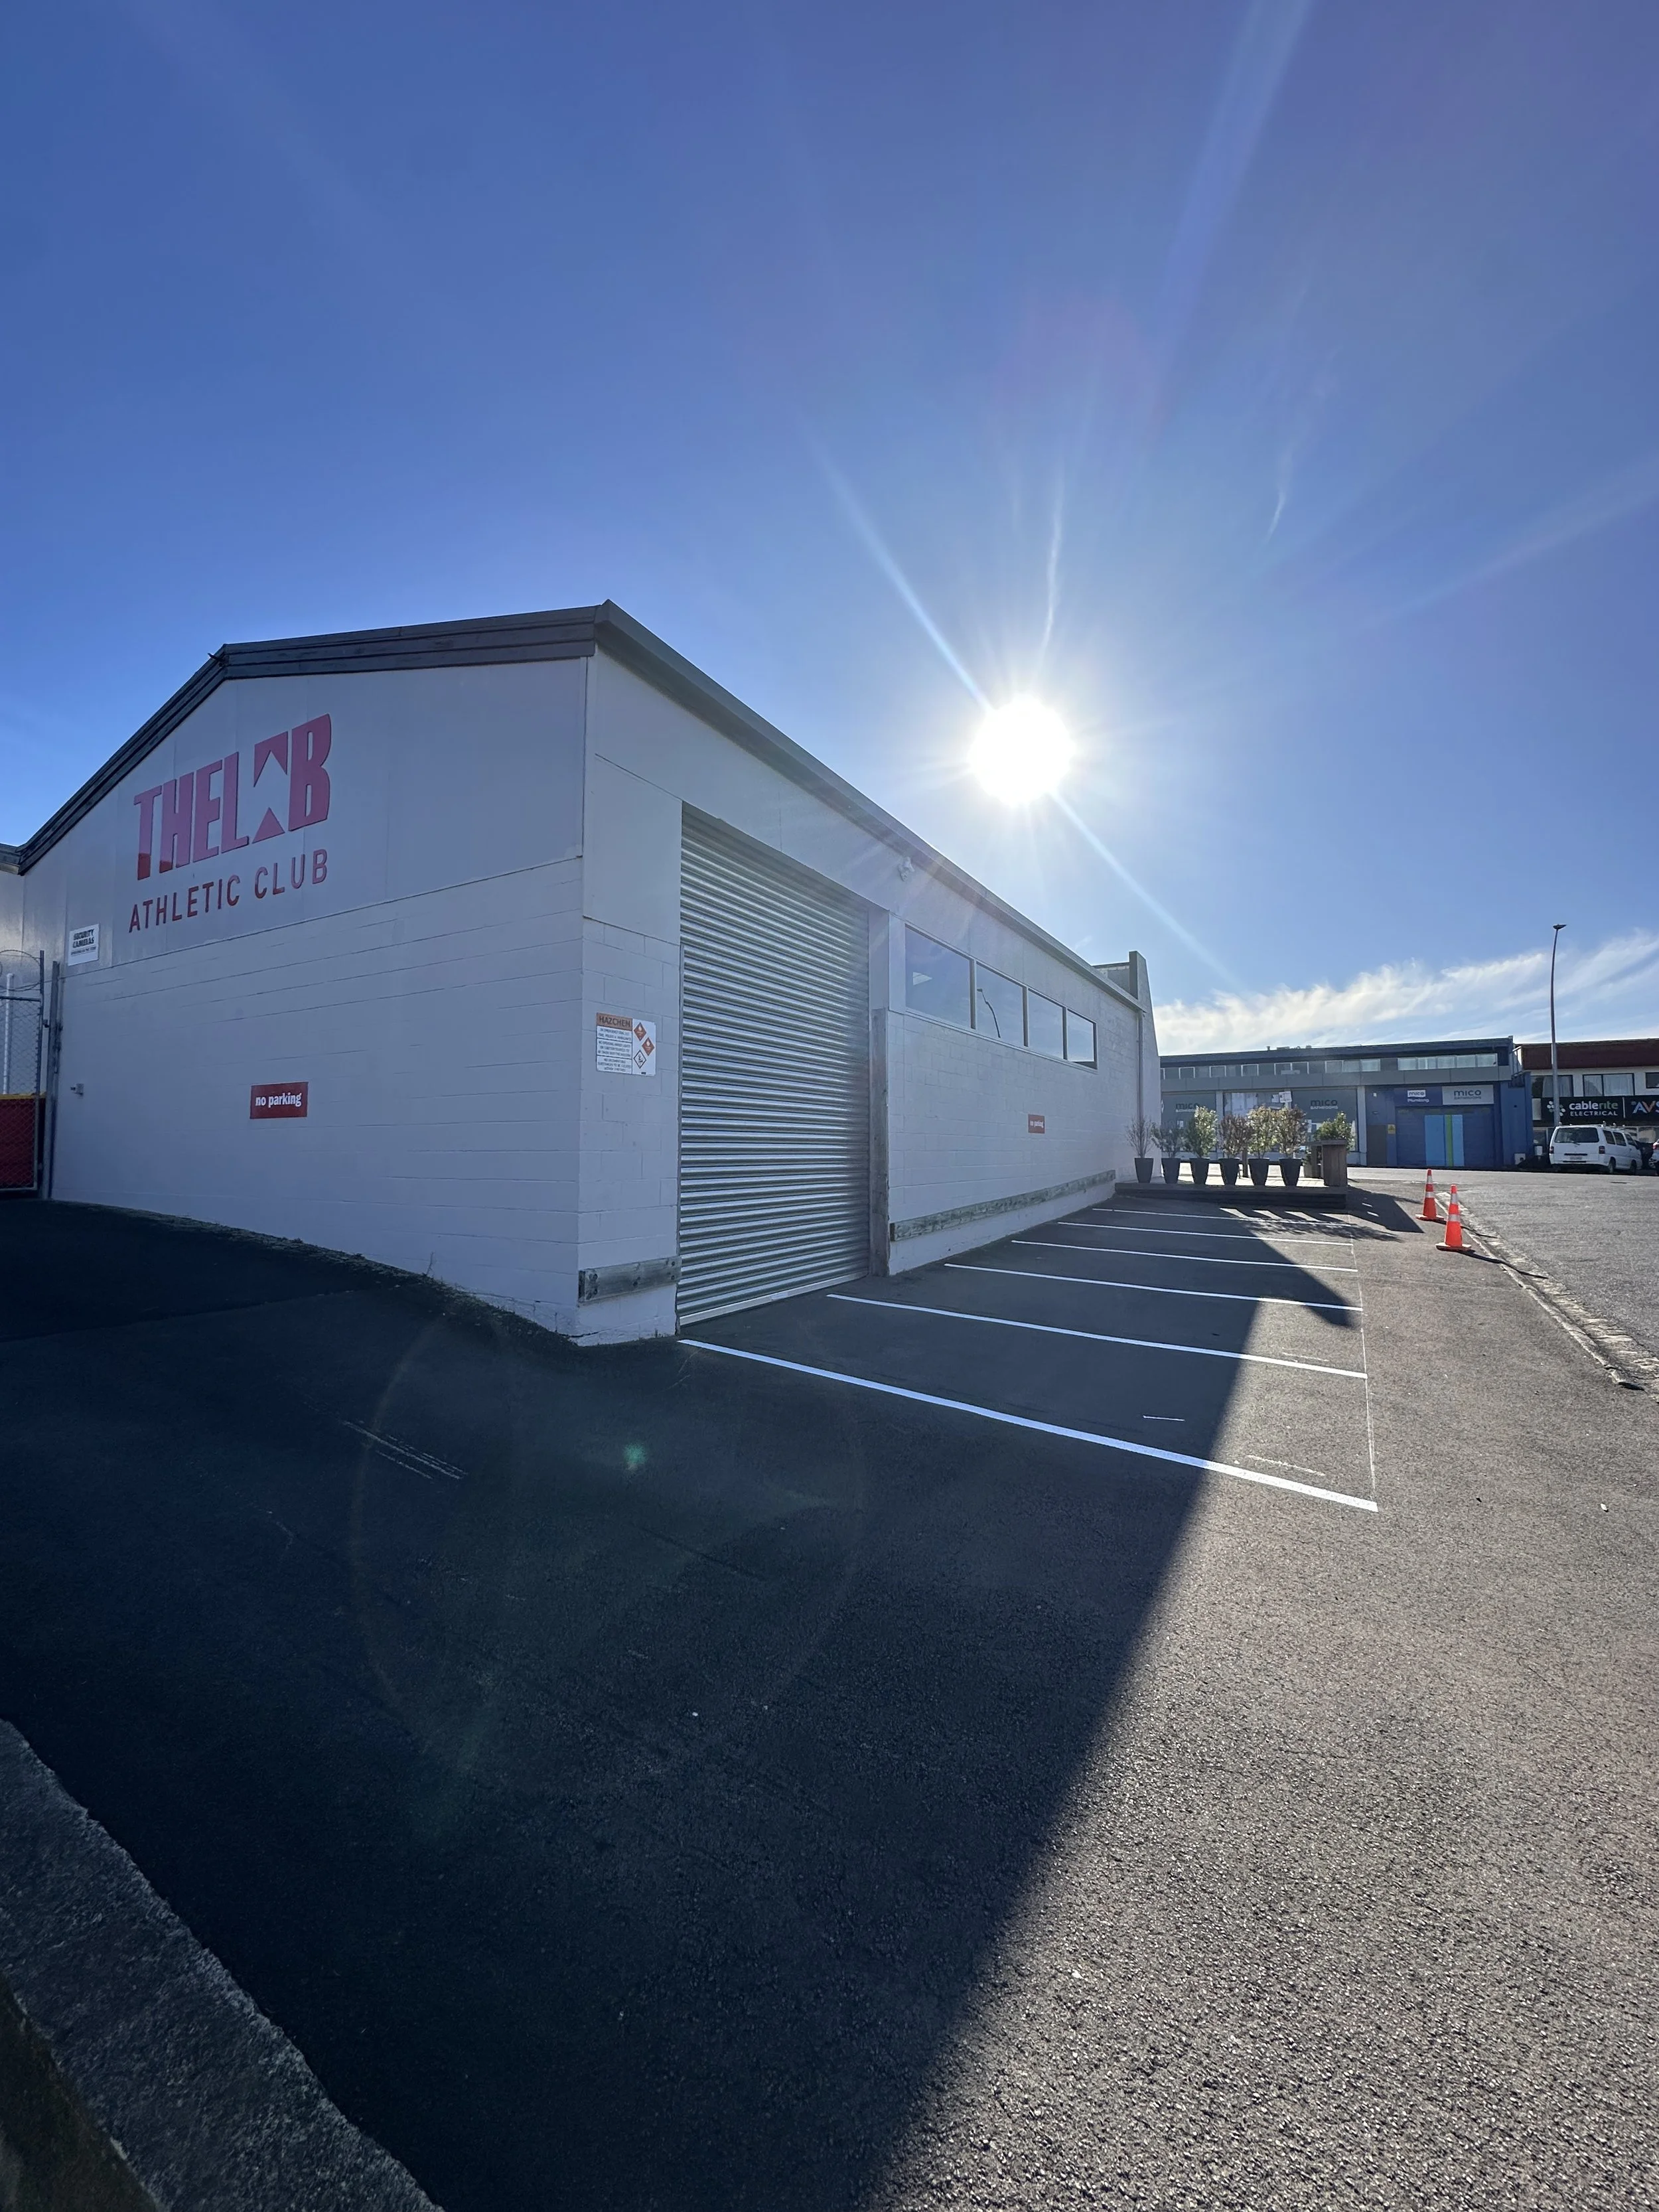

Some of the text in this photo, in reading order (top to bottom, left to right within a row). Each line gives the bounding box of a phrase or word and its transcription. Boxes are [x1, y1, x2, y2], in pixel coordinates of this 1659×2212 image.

[129, 848, 328, 933] ATHLETIC CLUB
[599, 1015, 631, 1028] HAZCHEM
[255, 1092, 303, 1108] no parking
[1569, 1100, 1619, 1110] cablerite
